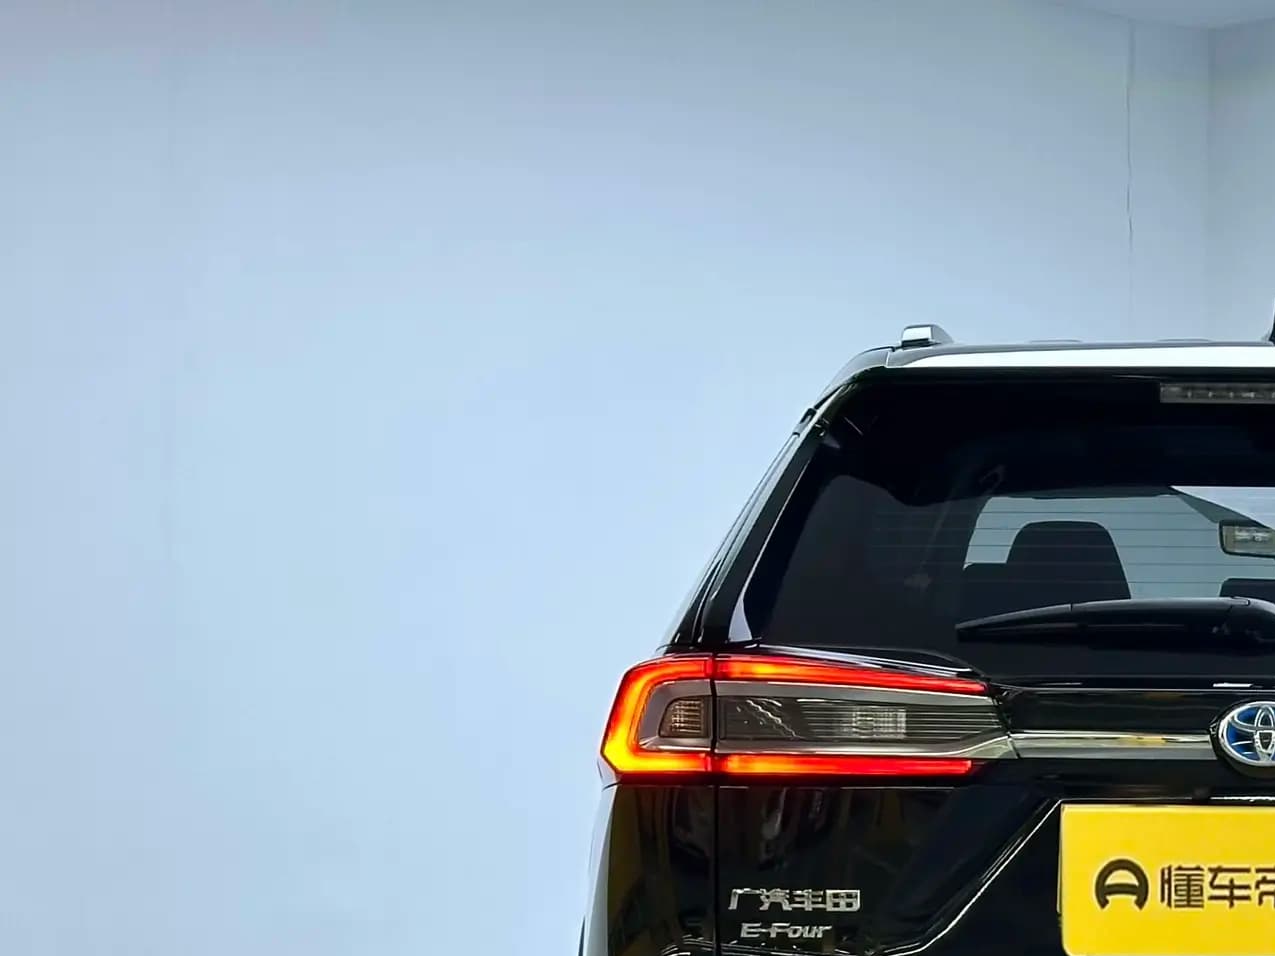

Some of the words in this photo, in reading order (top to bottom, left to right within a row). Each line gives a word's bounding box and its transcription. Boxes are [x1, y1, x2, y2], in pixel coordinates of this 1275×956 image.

[728, 888, 860, 911] 广汽丰田
[740, 922, 832, 938] E-Four
